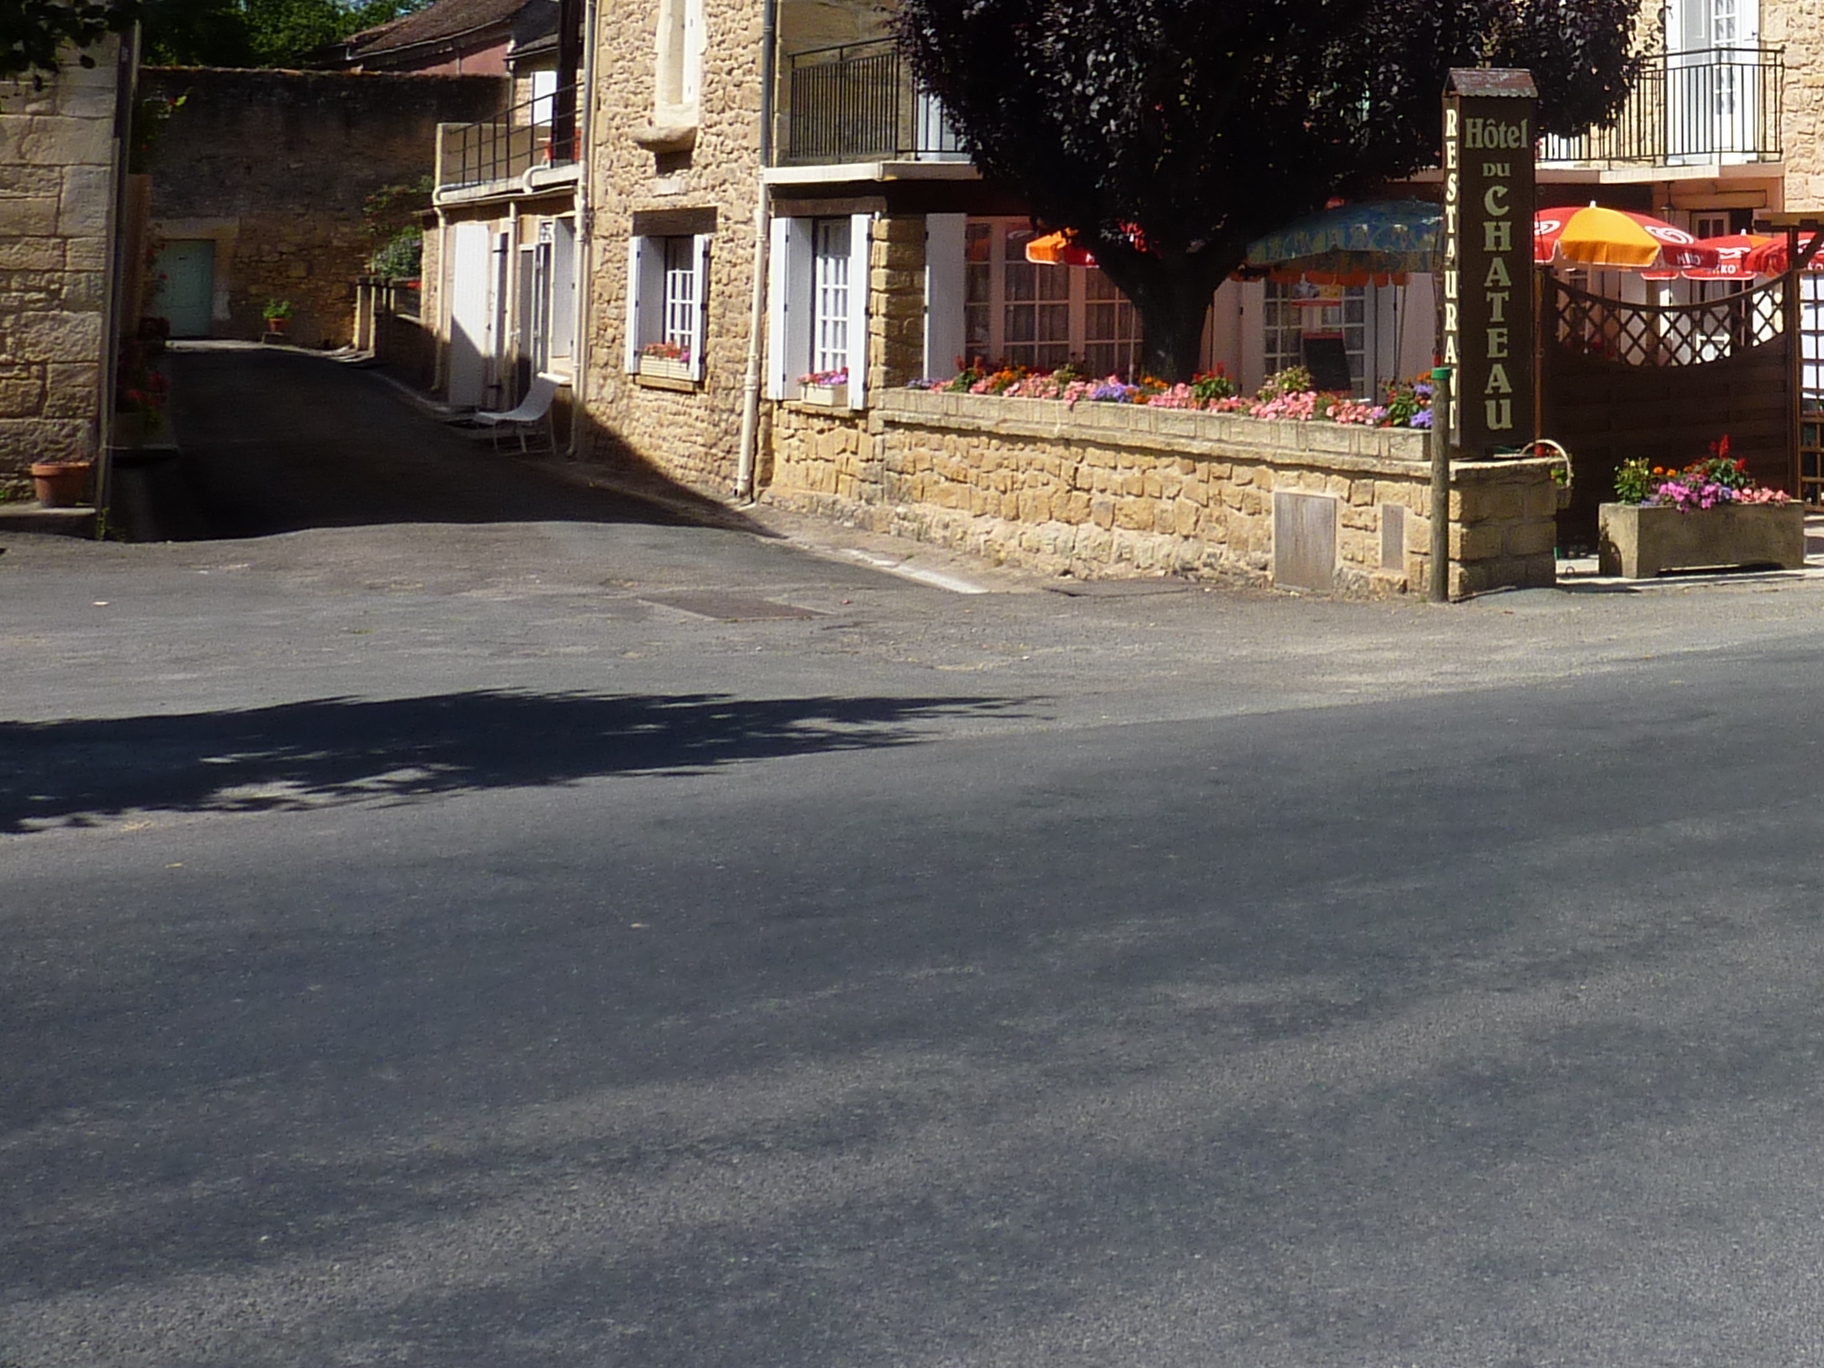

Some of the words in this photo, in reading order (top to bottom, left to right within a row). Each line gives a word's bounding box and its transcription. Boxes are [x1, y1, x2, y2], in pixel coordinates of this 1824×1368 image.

[1464, 118, 1528, 149] Hôtel
[1482, 163, 1512, 177] DU
[1482, 185, 1513, 431] CHATEAU
